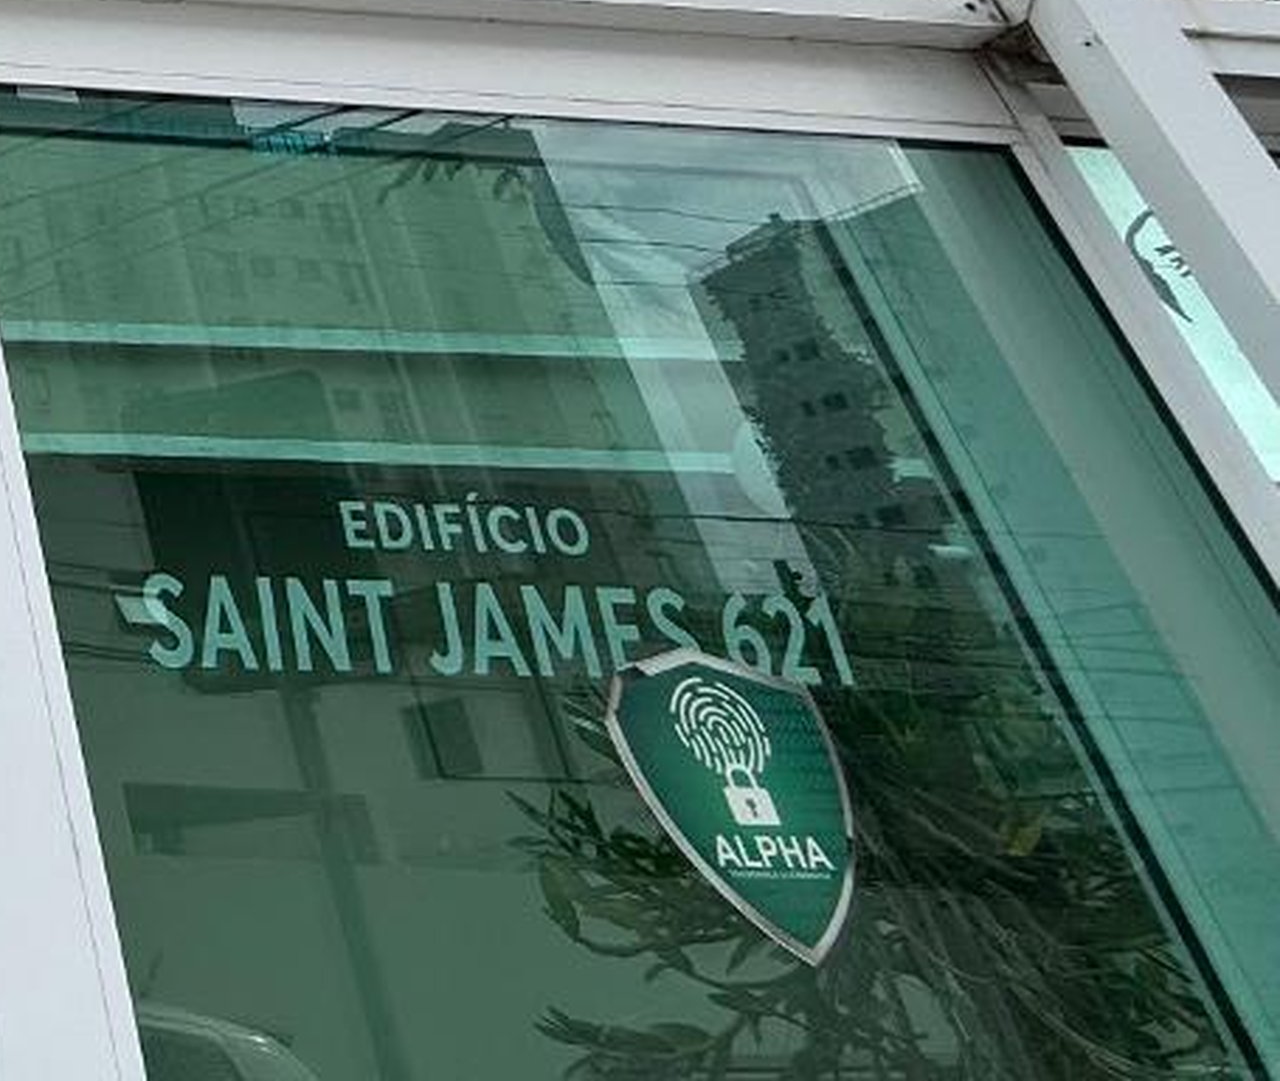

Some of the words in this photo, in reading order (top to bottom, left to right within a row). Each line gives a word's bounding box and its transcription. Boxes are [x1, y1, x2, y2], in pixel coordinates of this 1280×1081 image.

[339, 491, 591, 556] EDIFÍCIO
[142, 572, 393, 674] SAINT
[722, 588, 855, 687] 621
[716, 834, 838, 871] ALPHA
